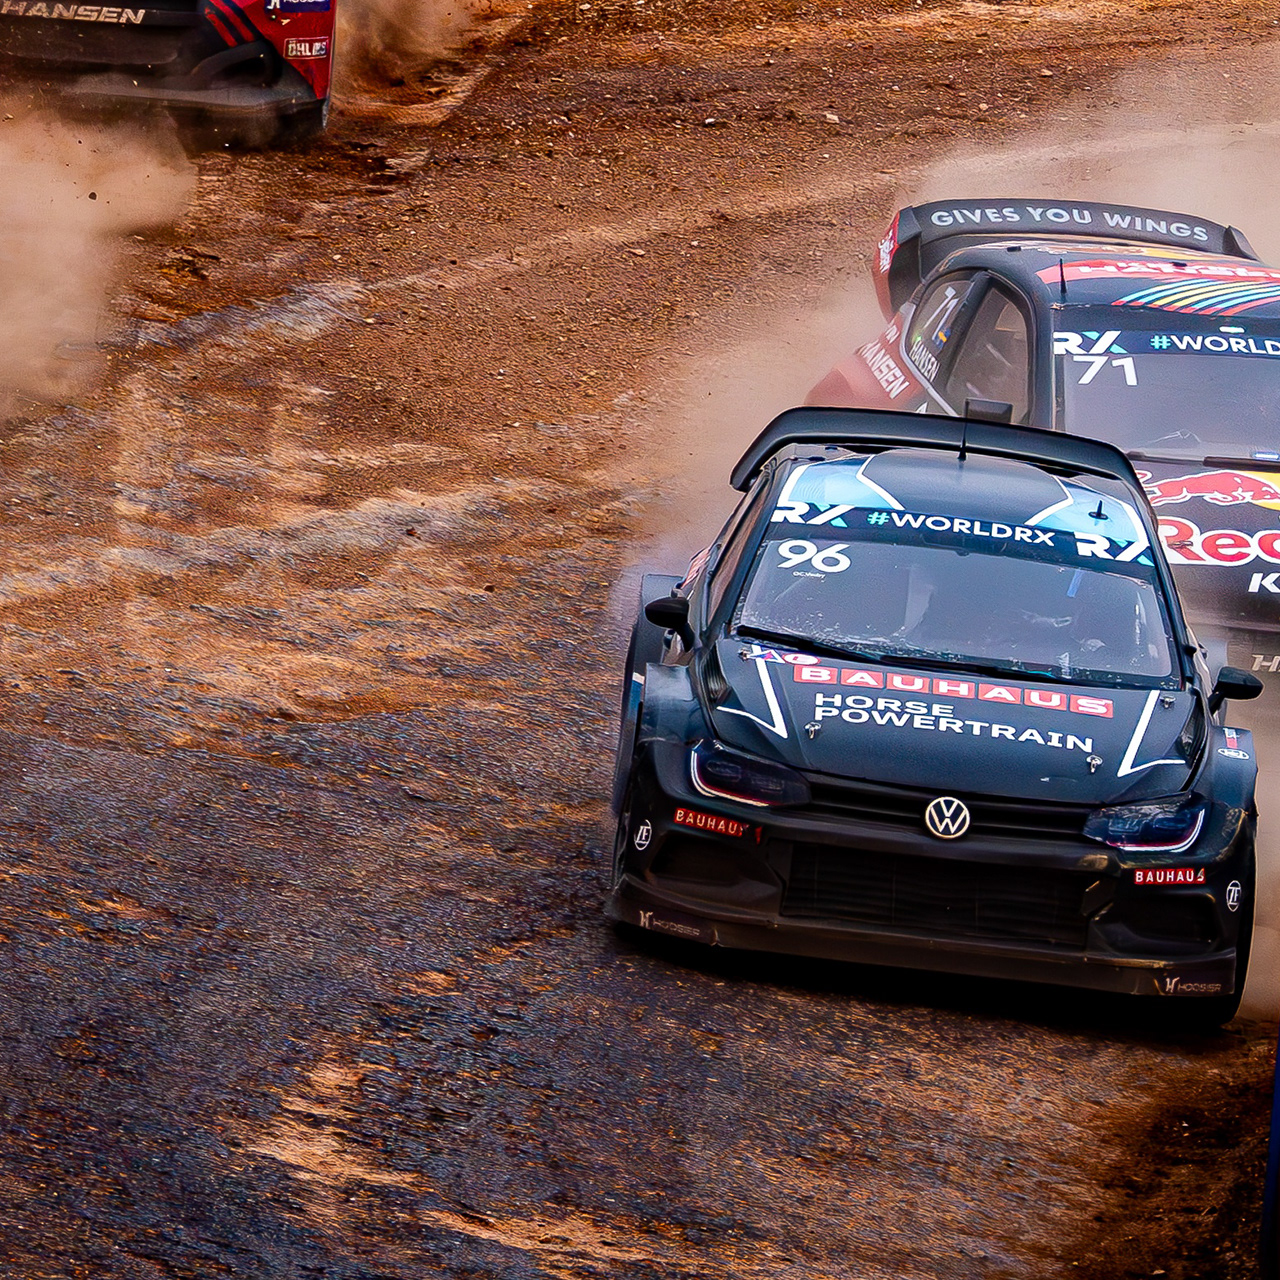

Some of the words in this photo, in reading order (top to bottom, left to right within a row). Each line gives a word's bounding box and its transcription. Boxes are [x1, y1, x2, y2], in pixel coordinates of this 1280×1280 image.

[0, 0, 146, 25] HANSEN
[930, 207, 1019, 228] GIVES
[1026, 207, 1094, 226] YOU
[1102, 209, 1210, 243] WINGS
[1052, 330, 1128, 355] RX
[1073, 355, 1139, 386] 71
[770, 501, 855, 528] RX
[866, 510, 1057, 547] #WORLDRX
[776, 539, 852, 573] 96
[1073, 531, 1156, 567] RX
[799, 666, 1111, 716] BAUHAUS
[815, 692, 955, 717] HORSE
[814, 707, 1095, 754] POWERTRAIN
